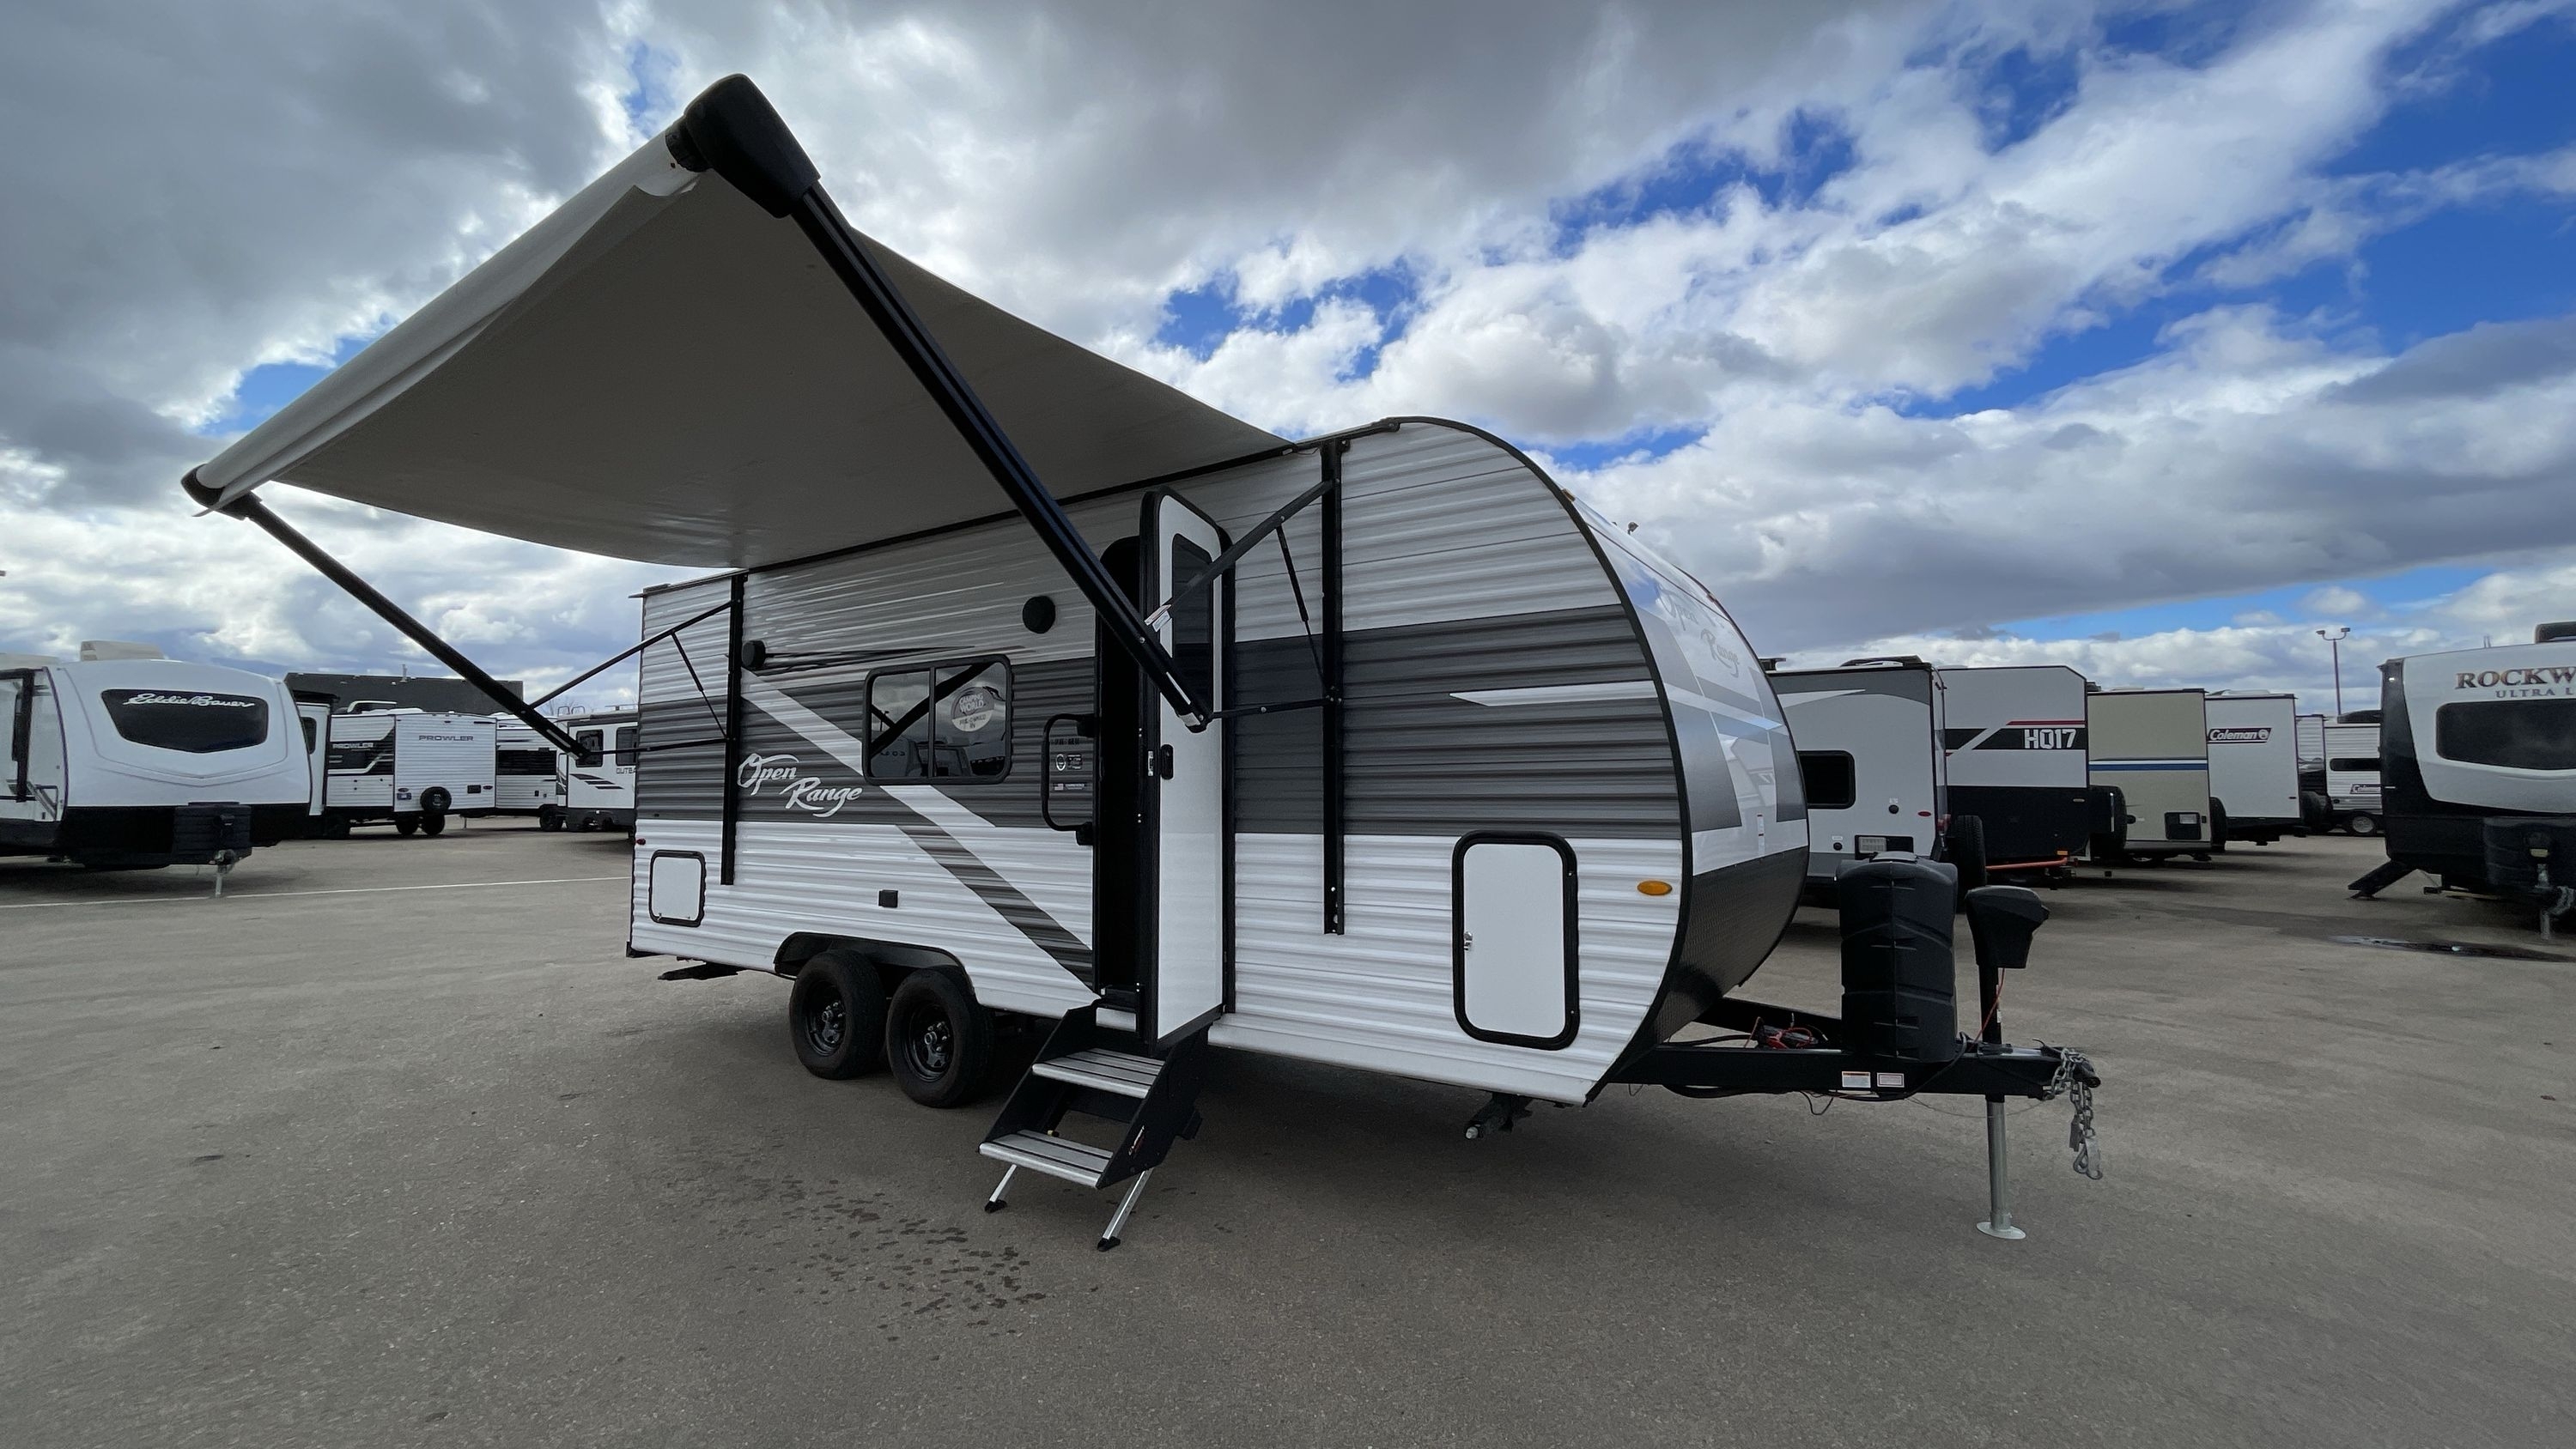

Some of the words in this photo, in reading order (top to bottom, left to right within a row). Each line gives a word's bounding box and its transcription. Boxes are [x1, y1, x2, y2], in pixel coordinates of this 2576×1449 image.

[123, 693, 190, 706] Eddie
[186, 695, 255, 707] Bauer
[2494, 688, 2556, 699] ULTRA
[959, 699, 984, 712] WORLD
[2209, 729, 2257, 741] Coleman
[737, 753, 799, 796] Open
[779, 777, 863, 818] Range
